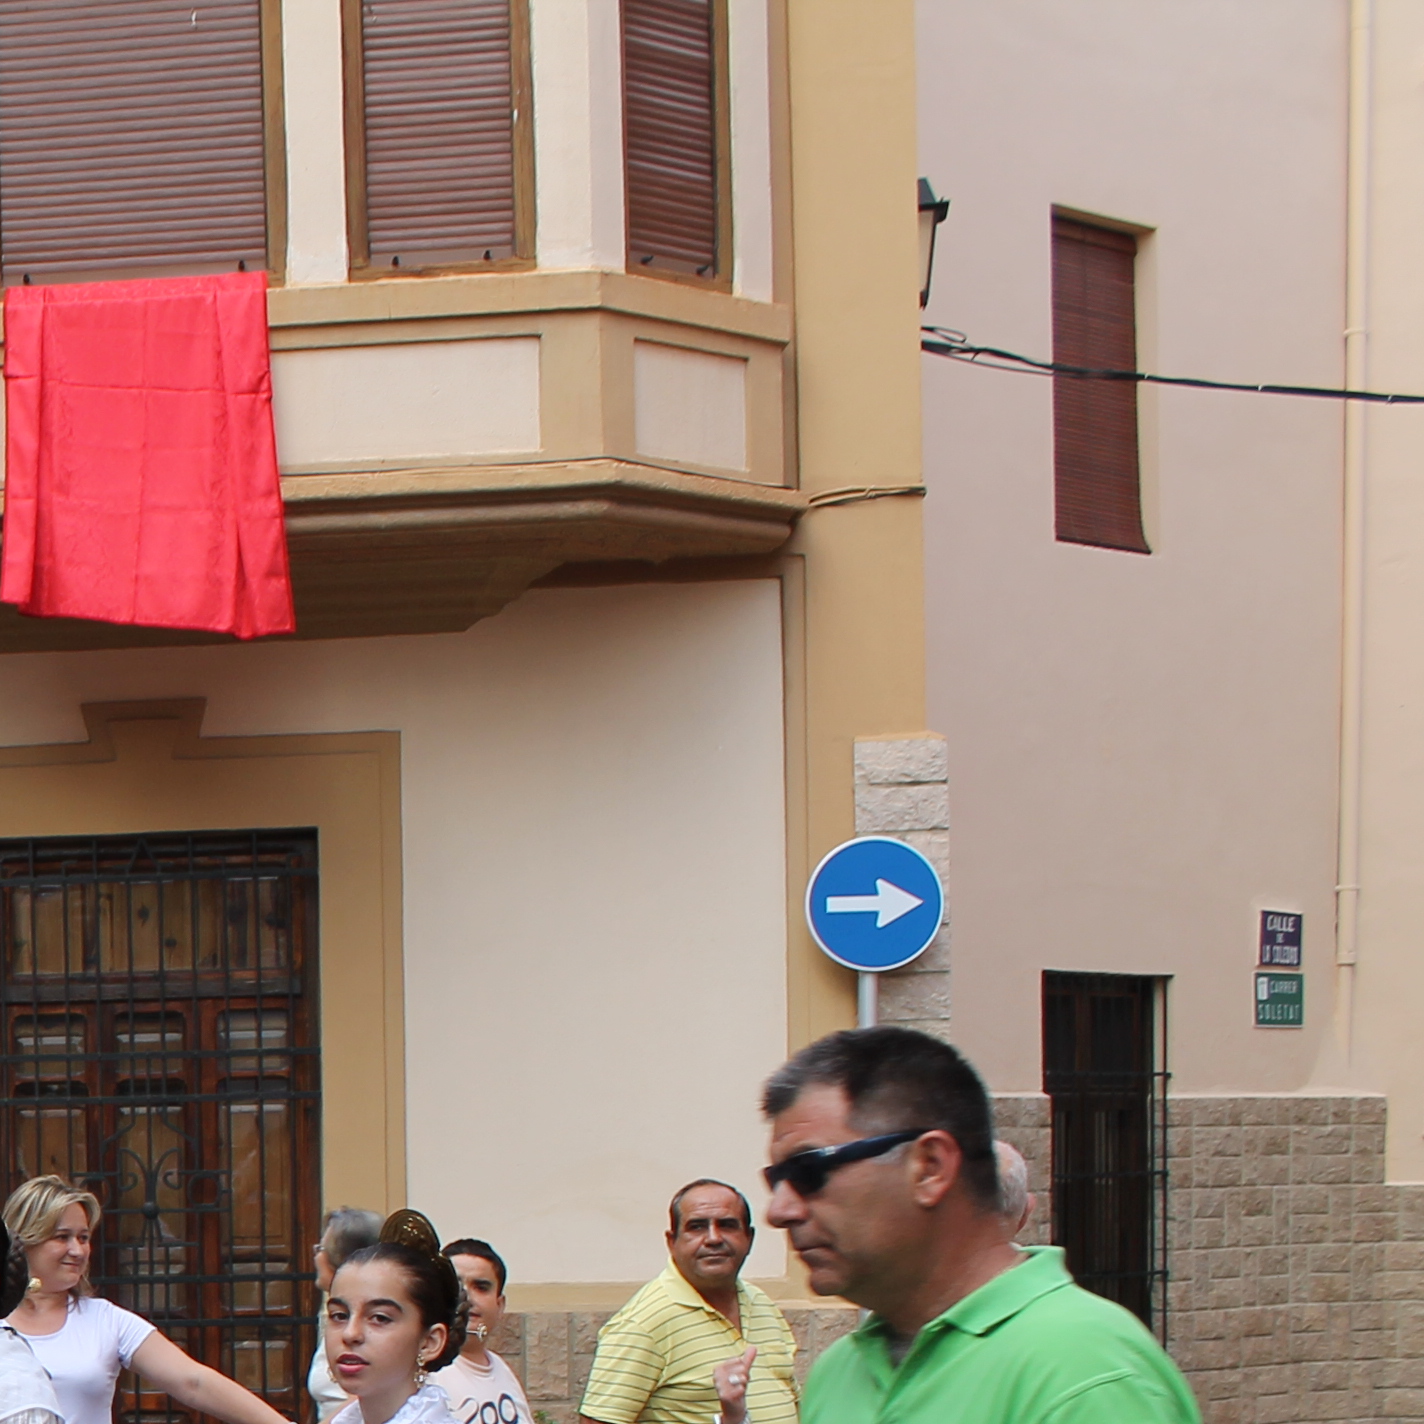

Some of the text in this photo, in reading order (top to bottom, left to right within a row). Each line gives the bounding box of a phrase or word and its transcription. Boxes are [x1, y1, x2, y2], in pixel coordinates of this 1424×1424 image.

[1267, 915, 1295, 931] CALLE
[1270, 981, 1298, 994] CARRER
[1258, 1004, 1299, 1019] SOLETAT
